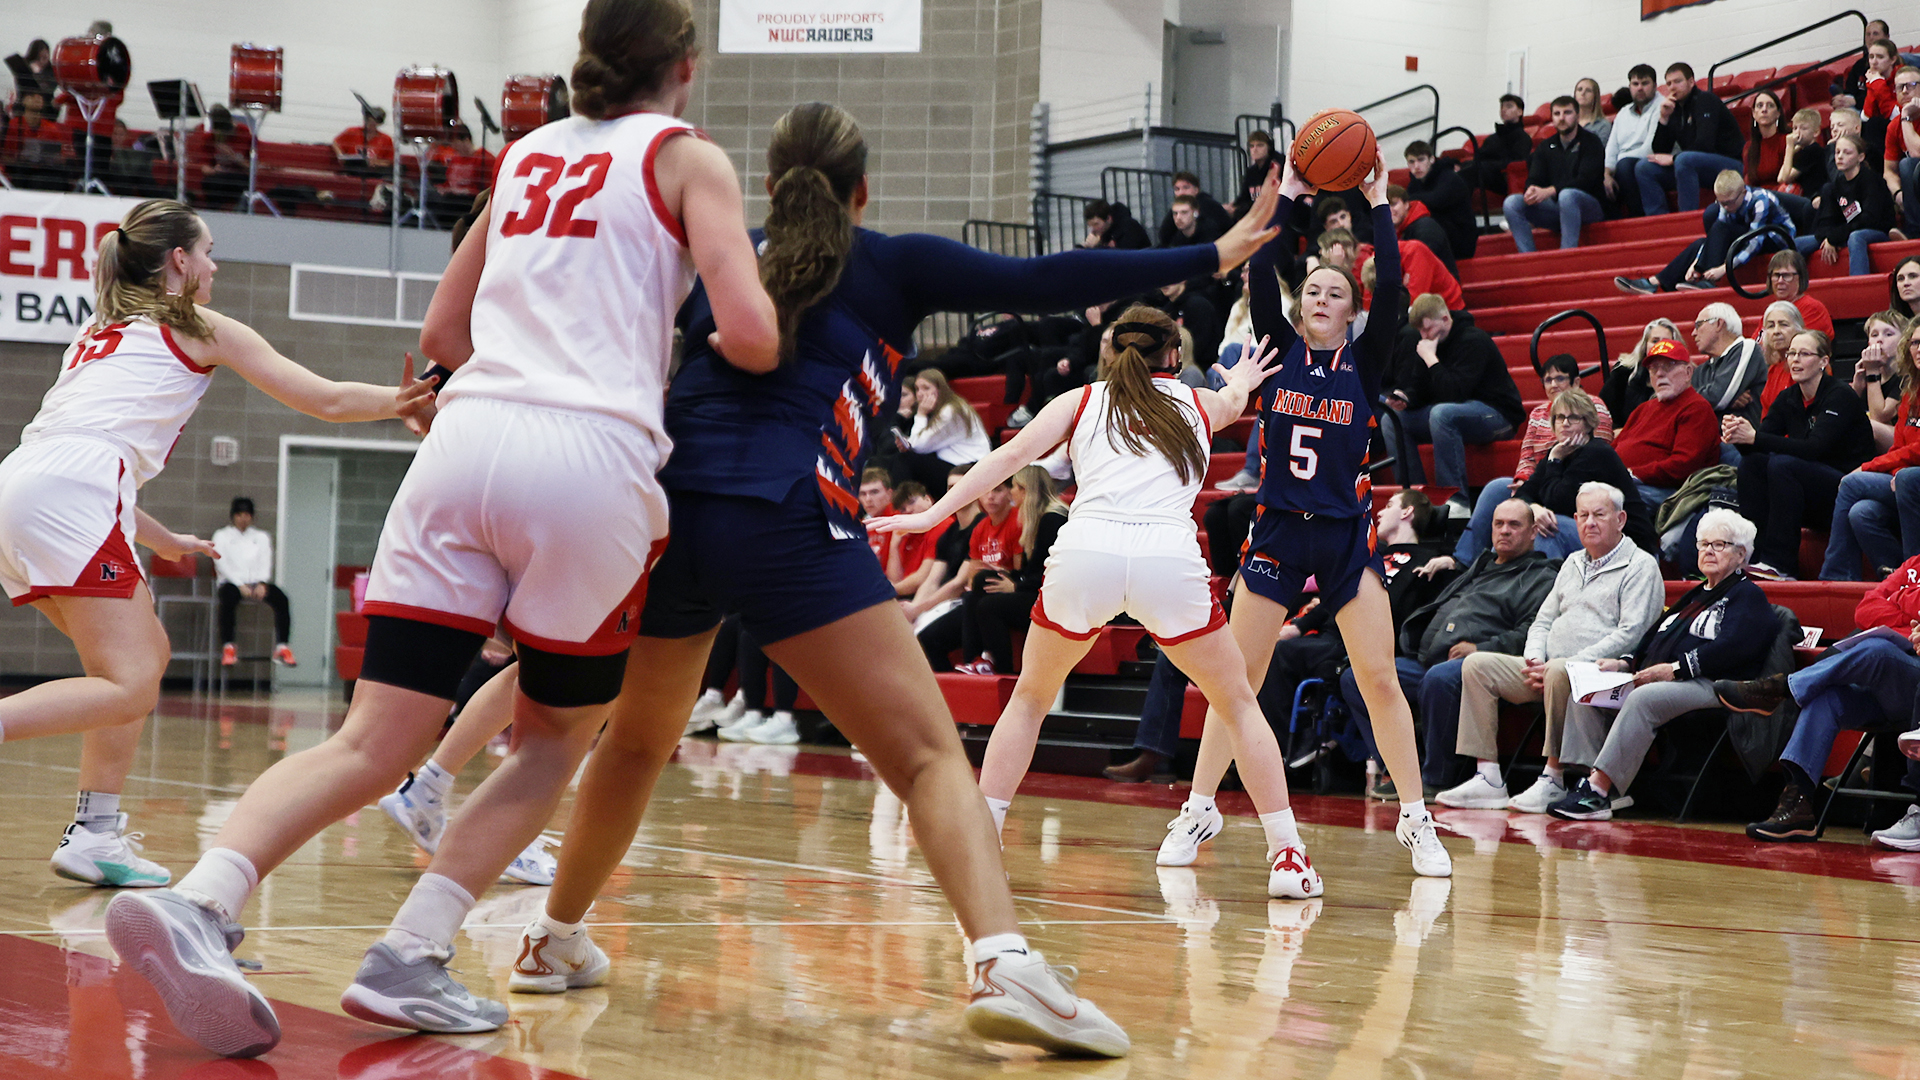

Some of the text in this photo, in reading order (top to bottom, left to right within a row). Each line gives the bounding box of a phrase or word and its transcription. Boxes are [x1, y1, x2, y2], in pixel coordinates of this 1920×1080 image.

[757, 13, 884, 24] PROUDLY SUPPORTS
[499, 152, 613, 239] 32
[67, 323, 130, 370] 15
[1271, 387, 1354, 426] MIDLAND
[1289, 423, 1324, 481] 5
